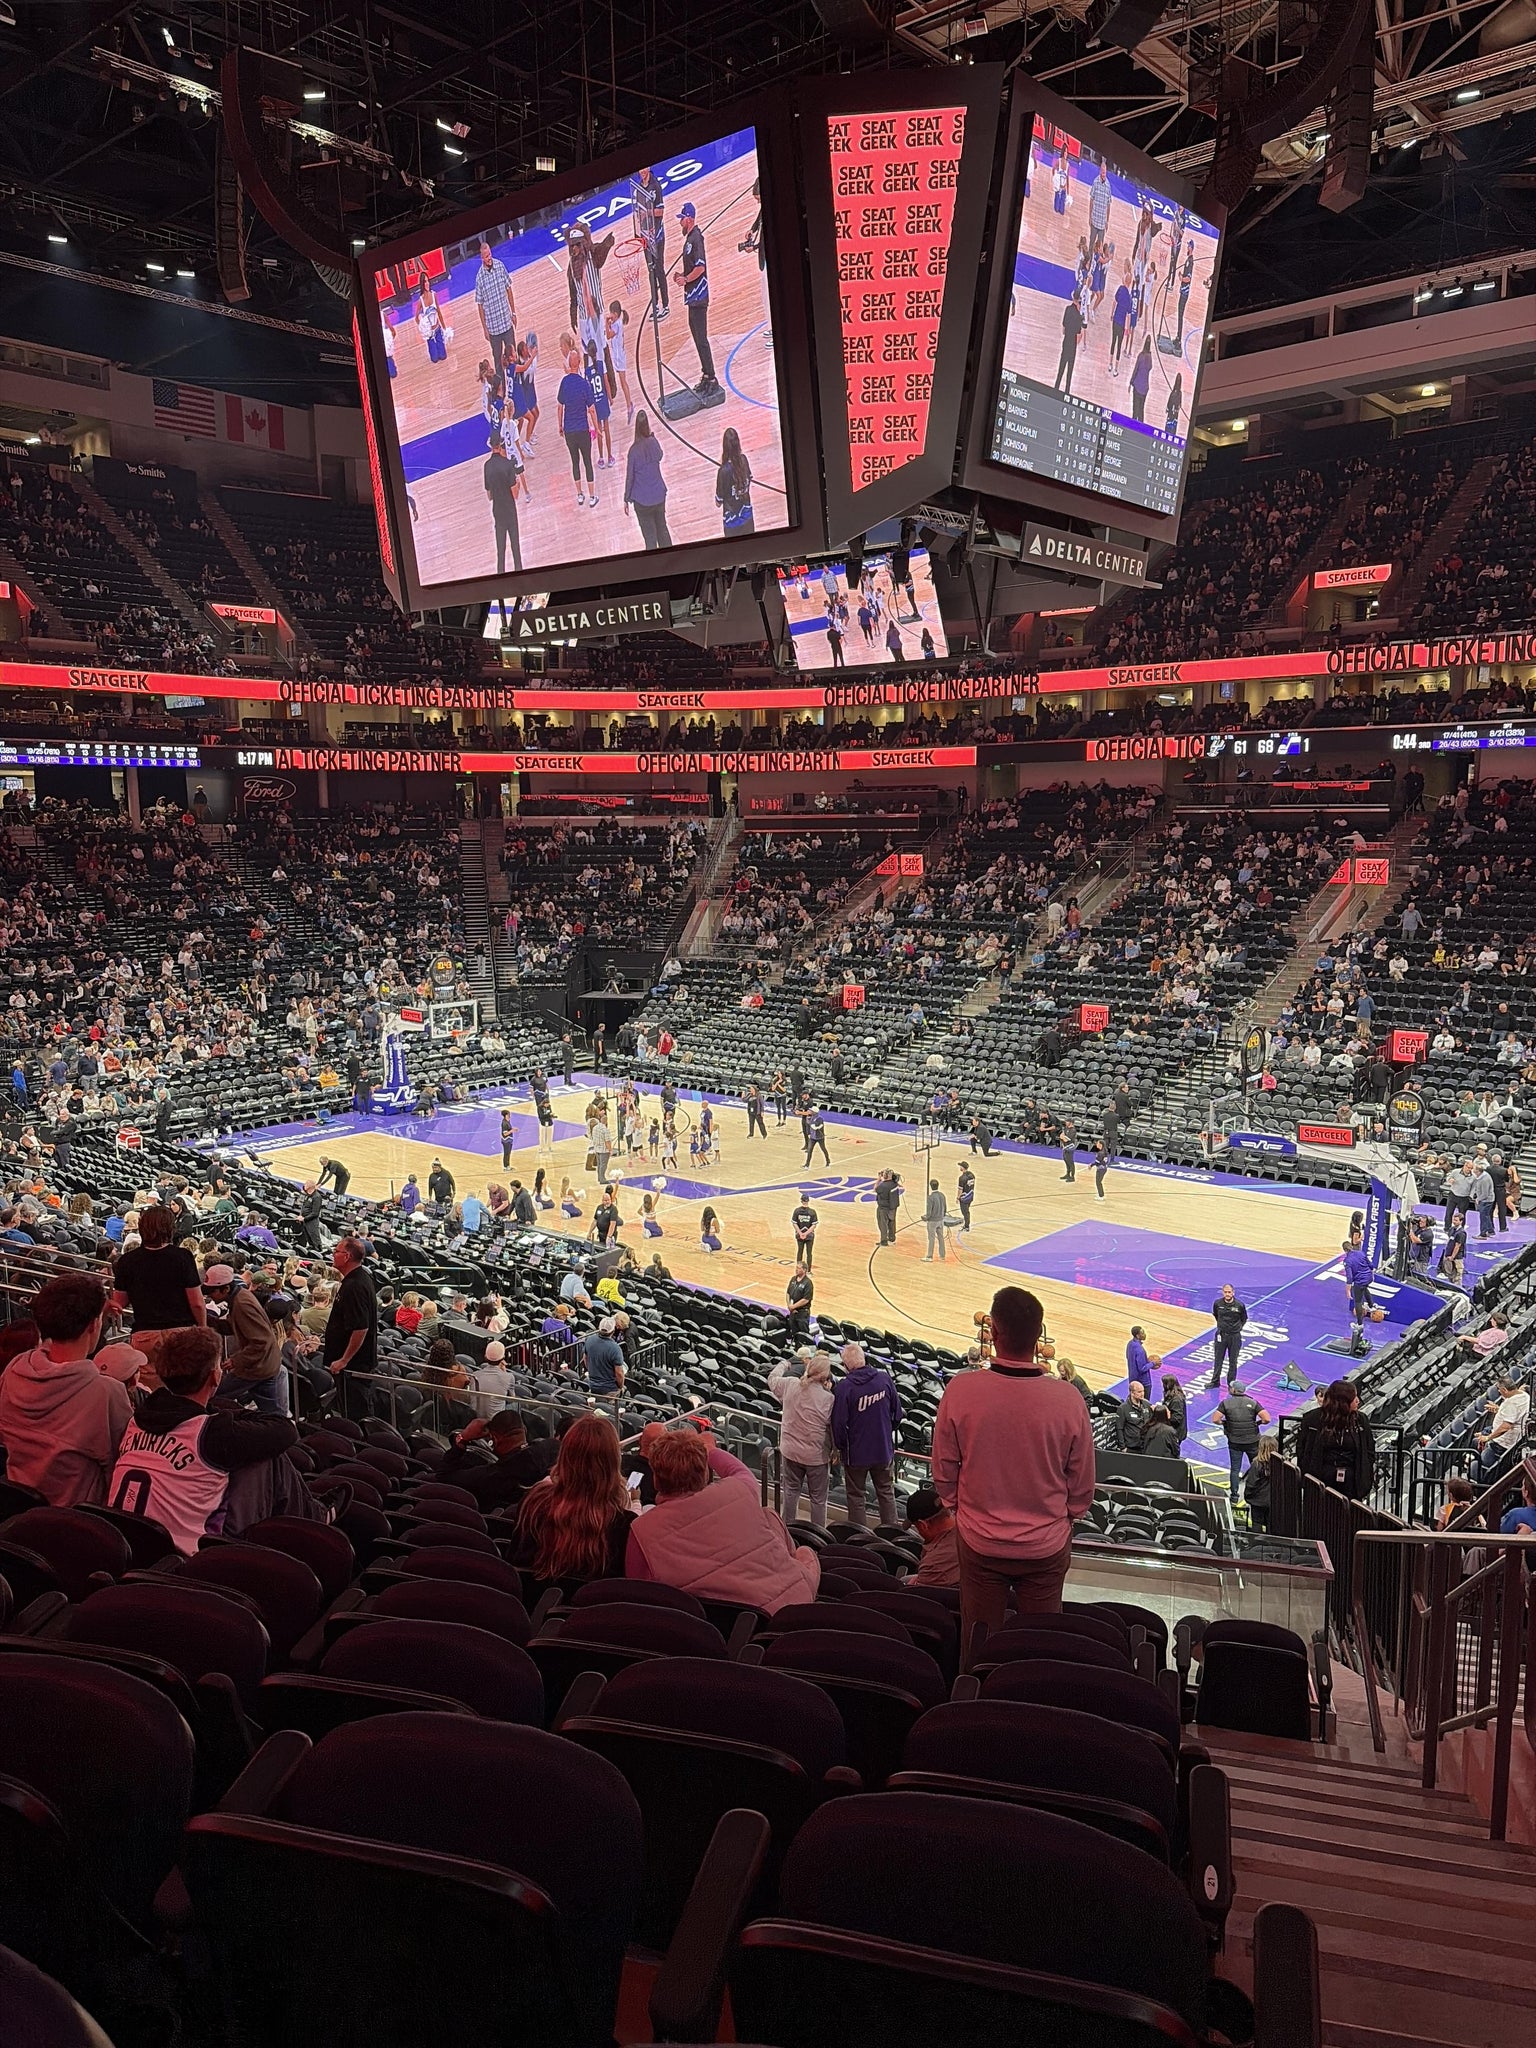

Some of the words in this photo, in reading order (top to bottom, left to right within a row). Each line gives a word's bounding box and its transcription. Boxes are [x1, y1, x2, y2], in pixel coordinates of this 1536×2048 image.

[862, 119, 896, 135] SEAT
[908, 116, 942, 132] SEAT
[860, 135, 898, 151] GEEK
[906, 131, 943, 147] GEEK
[839, 165, 873, 181] SEAT
[885, 162, 919, 178] SEAT
[837, 180, 875, 196] GEEK
[883, 177, 920, 193] GEEK
[862, 207, 896, 223] SEAT
[907, 203, 941, 219] SEAT
[860, 222, 897, 238] GEEK
[906, 218, 943, 234] GEEK
[840, 251, 873, 267] SEAT
[884, 248, 918, 264] SEAT
[839, 266, 875, 282] GEEK
[882, 263, 919, 278] GEEK
[862, 292, 896, 307] SEAT
[907, 289, 940, 304] SEAT
[861, 307, 896, 322] GEEK
[905, 304, 942, 319] GEEK
[843, 336, 873, 350] SEAT
[884, 333, 917, 347] SEAT
[882, 347, 919, 362] GEEK
[862, 375, 895, 390] SEAT
[861, 389, 896, 404] GEEK
[884, 414, 917, 428] SEAT
[882, 428, 919, 442] GEEK
[862, 455, 896, 469] SEAT
[138, 465, 167, 479] Smith's
[1045, 538, 1092, 566] DELTA
[1096, 550, 1144, 577] CENTER
[1327, 568, 1377, 584] SEATGEEK
[534, 612, 591, 634] DELTA
[596, 602, 663, 626] CENTER
[1327, 647, 1421, 674] OFFICIAL
[69, 670, 151, 691] SEATGEEK
[1108, 664, 1182, 686] SEATGEEK
[279, 681, 352, 704] OFFICIAL
[352, 684, 439, 708] TICKETING
[441, 687, 515, 709] PARTNER
[824, 683, 893, 706] OFFICIAL
[894, 676, 970, 704] TICKETING
[973, 672, 1040, 700] PARTNER
[638, 693, 706, 708] SEATGEEK
[1095, 737, 1172, 761] OFFICIAL
[1234, 740, 1247, 754] 61
[1257, 739, 1274, 754] 68
[1393, 734, 1417, 750] 0:44
[238, 752, 256, 766] 8:17
[258, 752, 273, 767] PM
[300, 750, 384, 771] TICKETING
[388, 751, 462, 772] PARTNER
[515, 756, 584, 771] SEATGEEK
[637, 753, 707, 772] OFFICIAL
[709, 752, 791, 772] TICKETING
[872, 750, 934, 766] SEATGEEK
[244, 777, 284, 798] Ford
[1400, 1038, 1421, 1046] SEAT
[1304, 1129, 1347, 1141] SEATGEEK
[1371, 1195, 1380, 1222] FIRST
[1366, 1222, 1378, 1262] AMERICA
[725, 1246, 795, 1266] DELTA
[857, 1390, 886, 1412] UTAH
[112, 1469, 152, 1514] 0
[1208, 1876, 1215, 1887] 21
